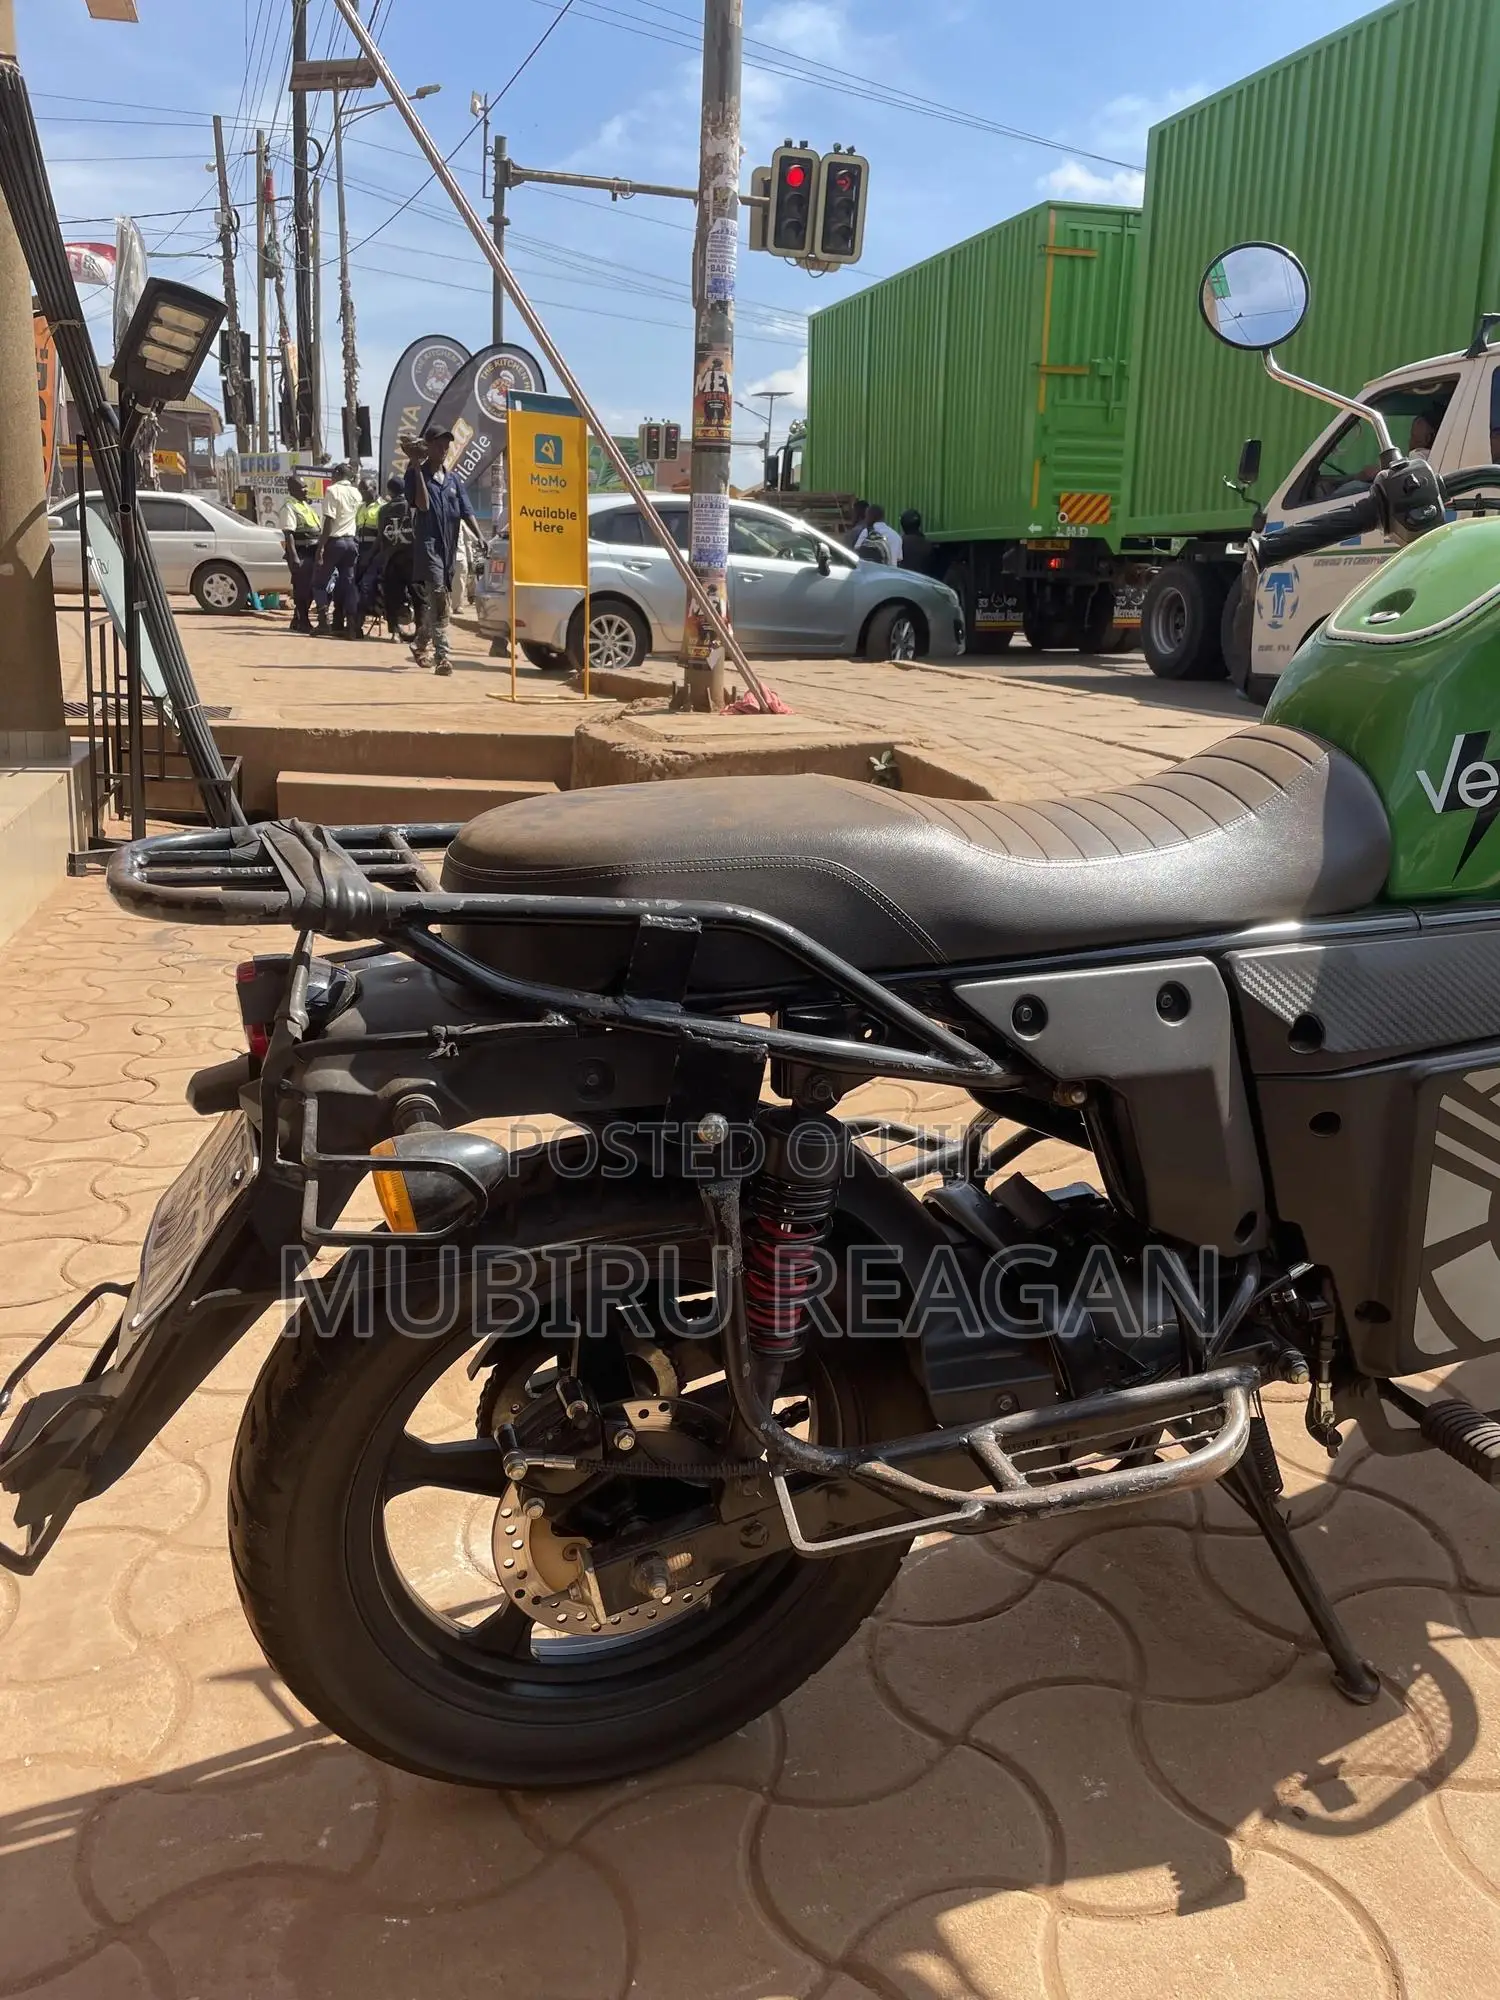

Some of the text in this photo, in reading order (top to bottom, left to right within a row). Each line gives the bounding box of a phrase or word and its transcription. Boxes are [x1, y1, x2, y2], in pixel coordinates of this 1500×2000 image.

[480, 364, 495, 380] THE
[493, 358, 528, 380] KITCHEN
[529, 473, 568, 489] MoMo
[519, 504, 577, 521] Available
[533, 521, 564, 534] Here
